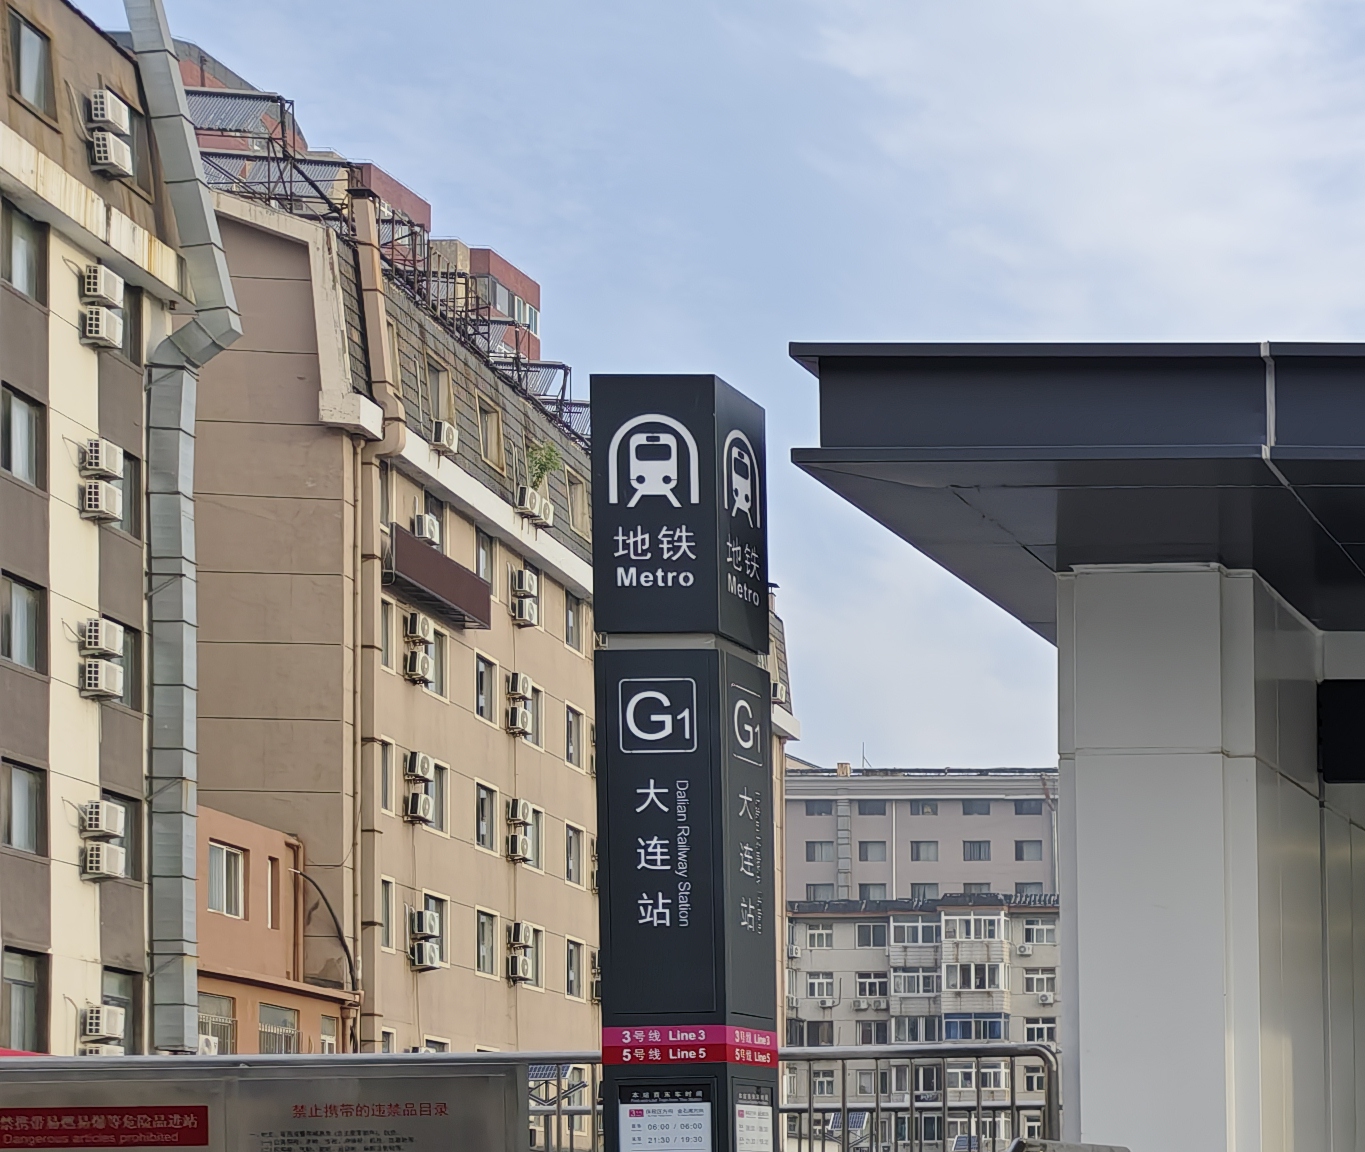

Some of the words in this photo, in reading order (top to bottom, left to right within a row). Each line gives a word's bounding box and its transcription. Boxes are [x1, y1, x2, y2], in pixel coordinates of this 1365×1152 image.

[614, 525, 696, 561] 地铁
[726, 533, 761, 582] 地铁
[616, 567, 694, 588] Metro
[727, 572, 760, 606] Metro
[626, 691, 691, 741] G1
[734, 699, 761, 754] G1
[675, 779, 689, 822] Dalian
[635, 779, 672, 928] 大连站
[675, 827, 691, 878] Railway
[738, 787, 755, 932] 大连站
[678, 881, 692, 927] Station
[622, 1030, 661, 1043] 3号线
[668, 1029, 696, 1040] Line
[698, 1029, 706, 1040] 3
[622, 1048, 661, 1061] 5号线
[669, 1048, 697, 1059] Line
[698, 1048, 706, 1059] 5
[292, 1102, 449, 1119] 禁止携带的违禁品目录
[647, 1123, 670, 1131] 06:00
[3, 1134, 69, 1147] Dangerous
[72, 1132, 115, 1144] articles
[119, 1130, 179, 1145] prohibited
